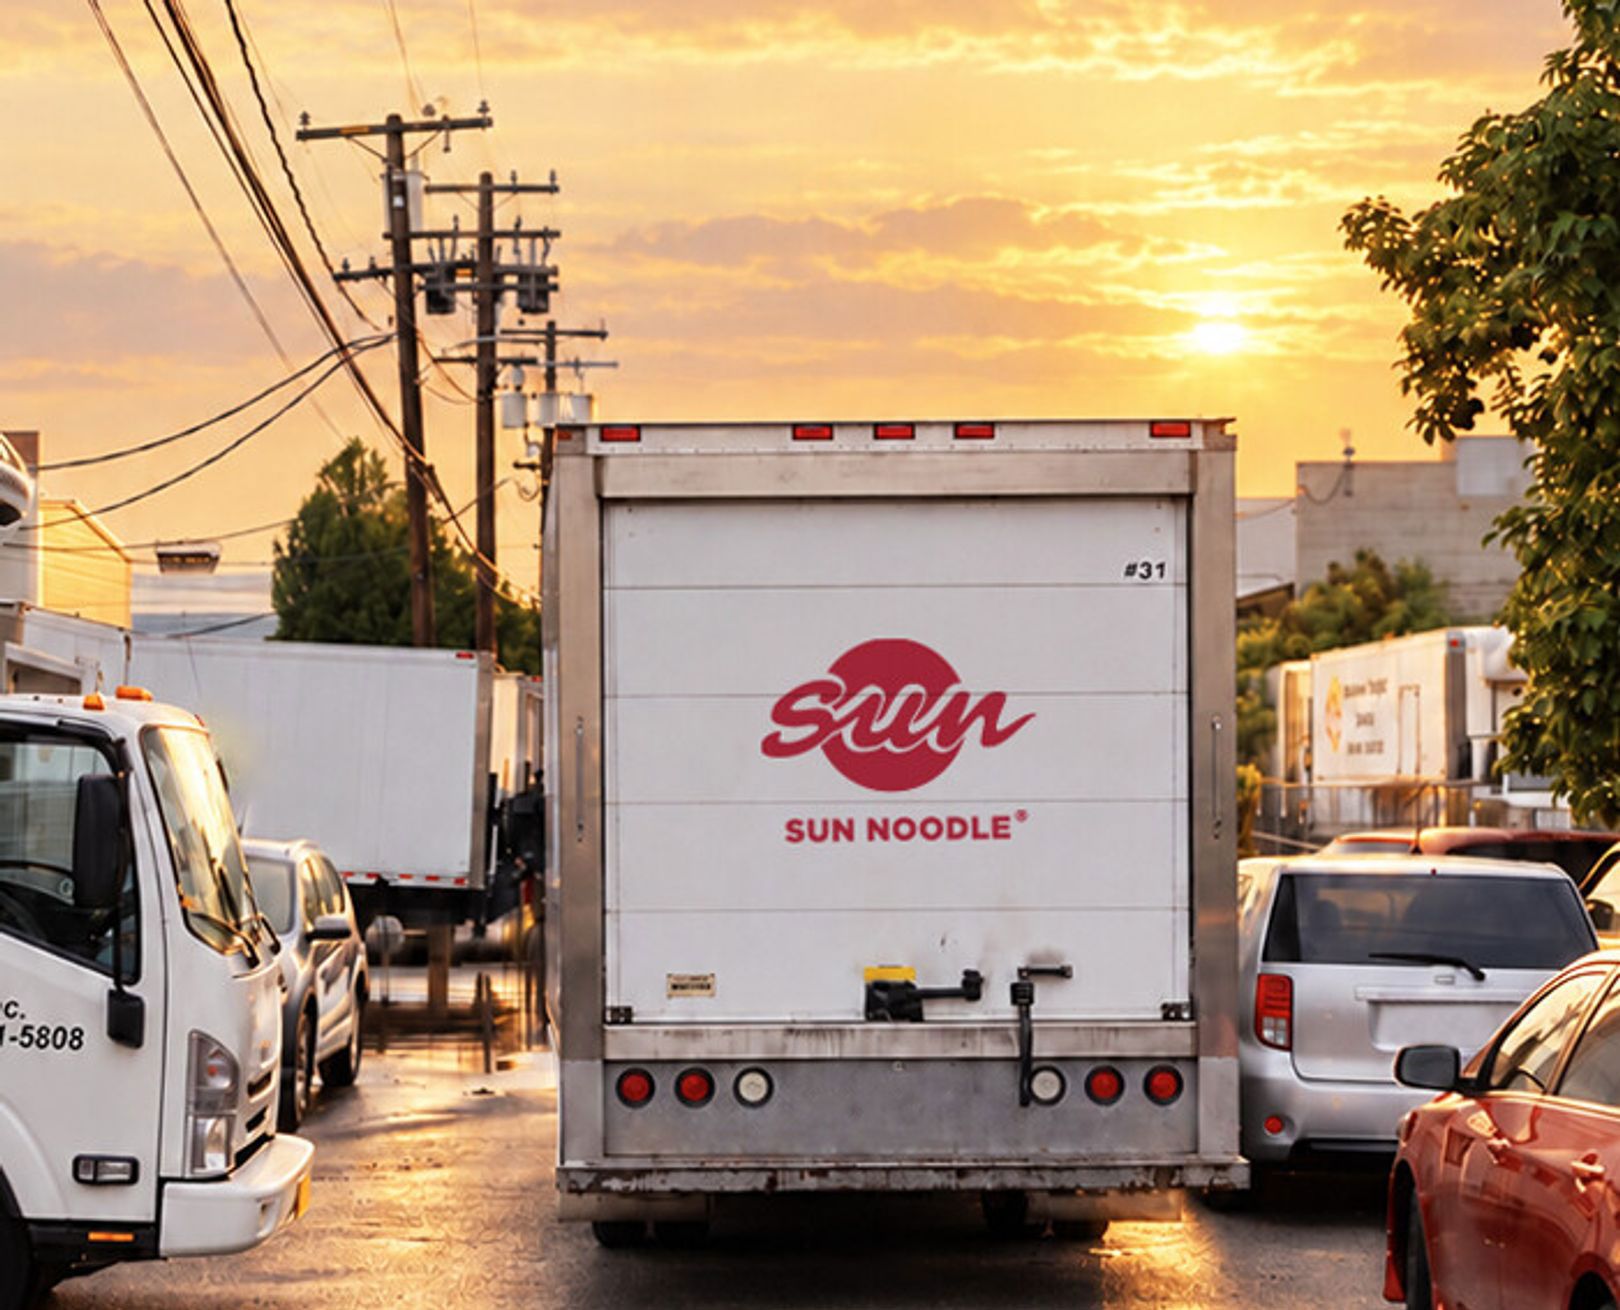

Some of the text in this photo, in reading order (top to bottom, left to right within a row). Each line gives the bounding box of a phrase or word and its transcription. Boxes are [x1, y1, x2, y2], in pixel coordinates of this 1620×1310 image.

[1124, 561, 1165, 580] #31
[785, 818, 854, 843] SUN
[0, 1000, 26, 1020] c.
